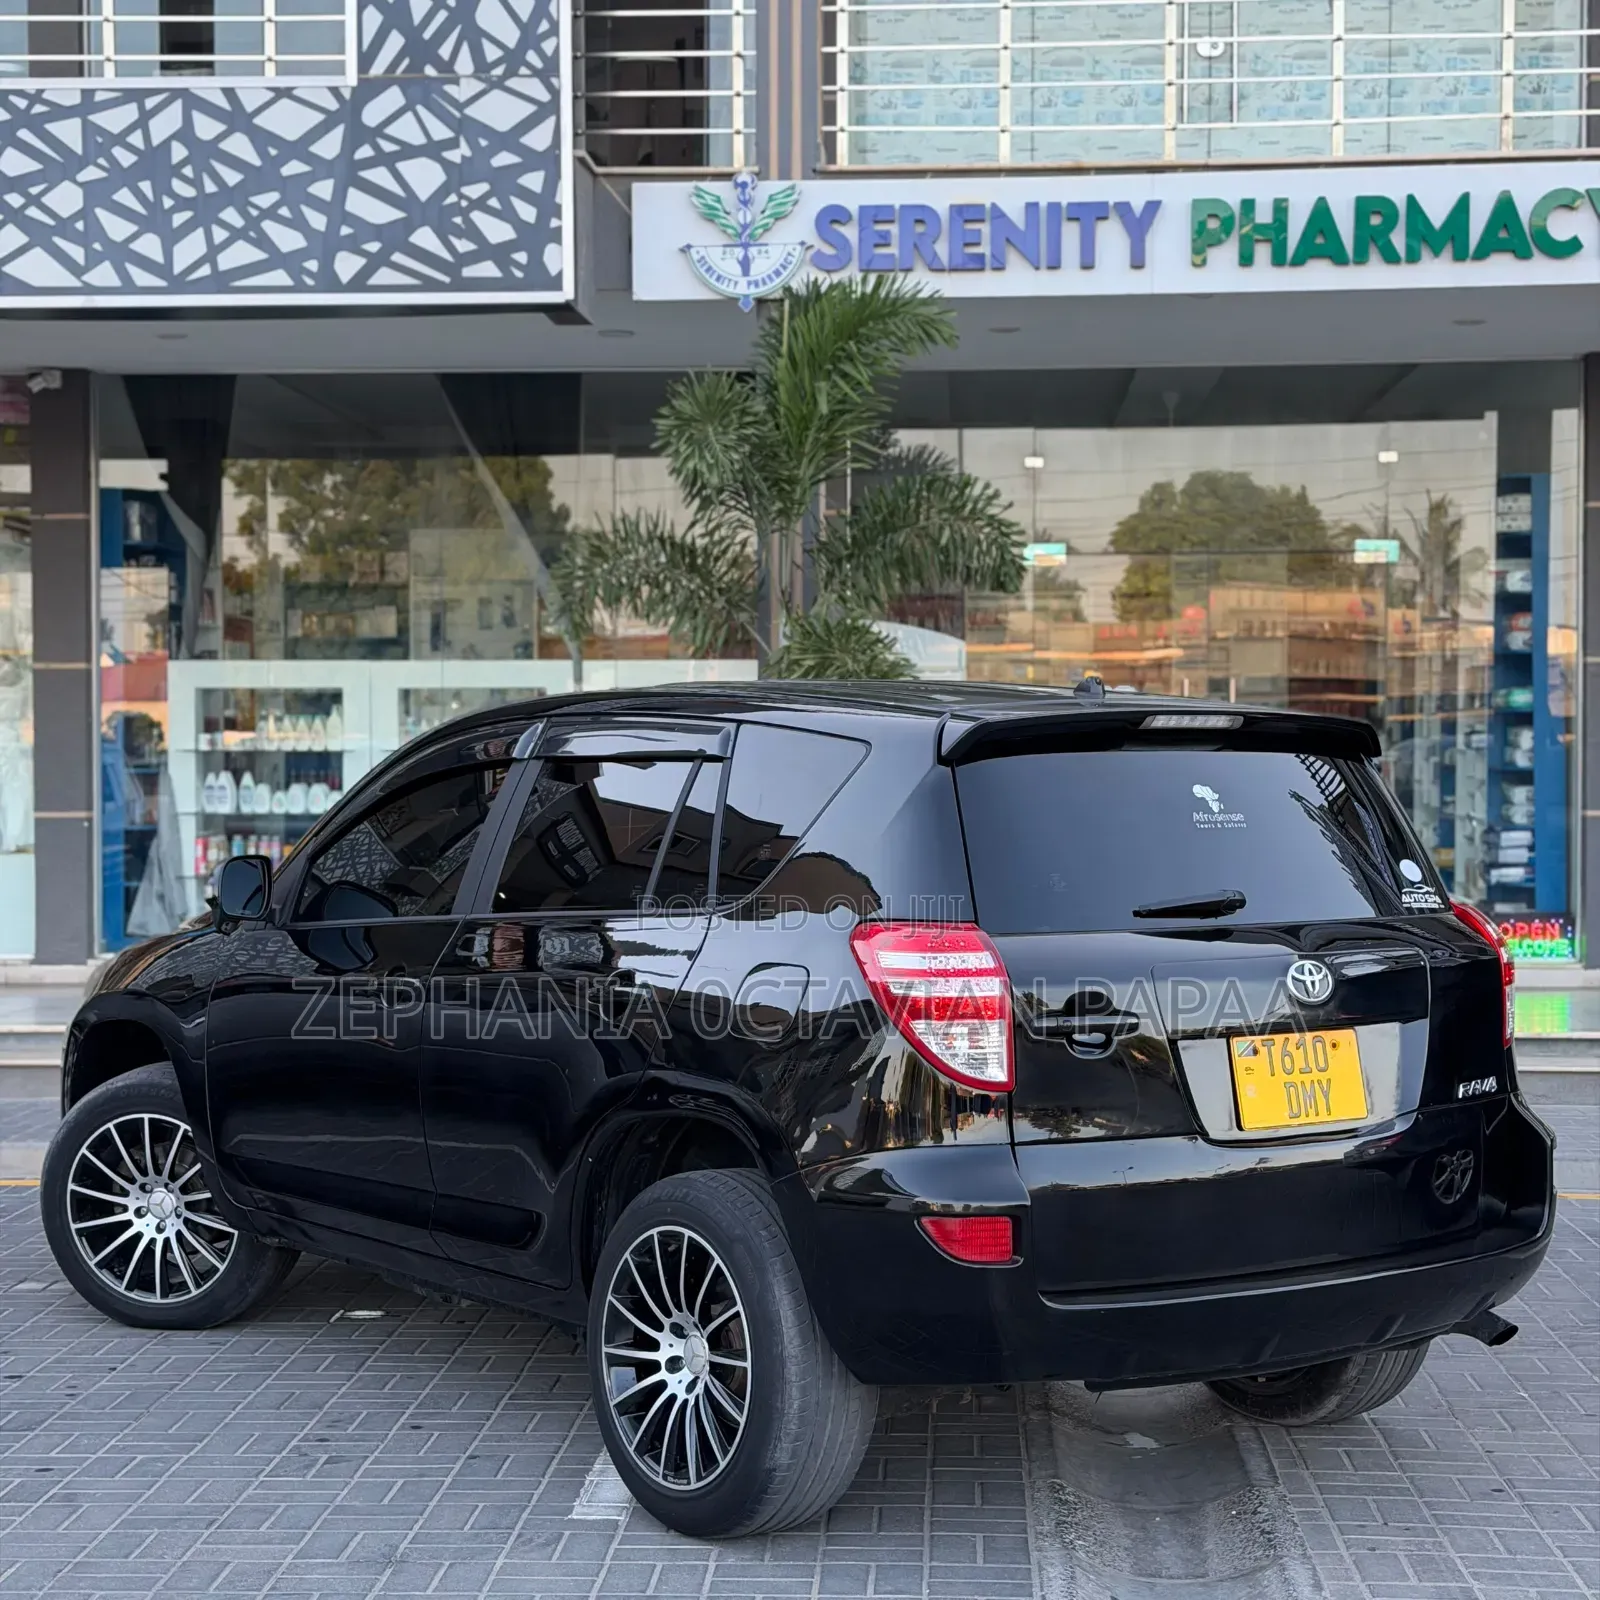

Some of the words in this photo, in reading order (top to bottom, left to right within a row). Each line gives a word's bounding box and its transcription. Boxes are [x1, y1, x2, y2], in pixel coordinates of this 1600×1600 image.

[810, 199, 1162, 272] SERENITY
[1190, 187, 1600, 267] PHARMAC
[696, 254, 740, 290] SERENITY
[746, 251, 797, 290] PHARMACY
[1499, 922, 1560, 940] OPEN
[1283, 1078, 1332, 1119] DMY
